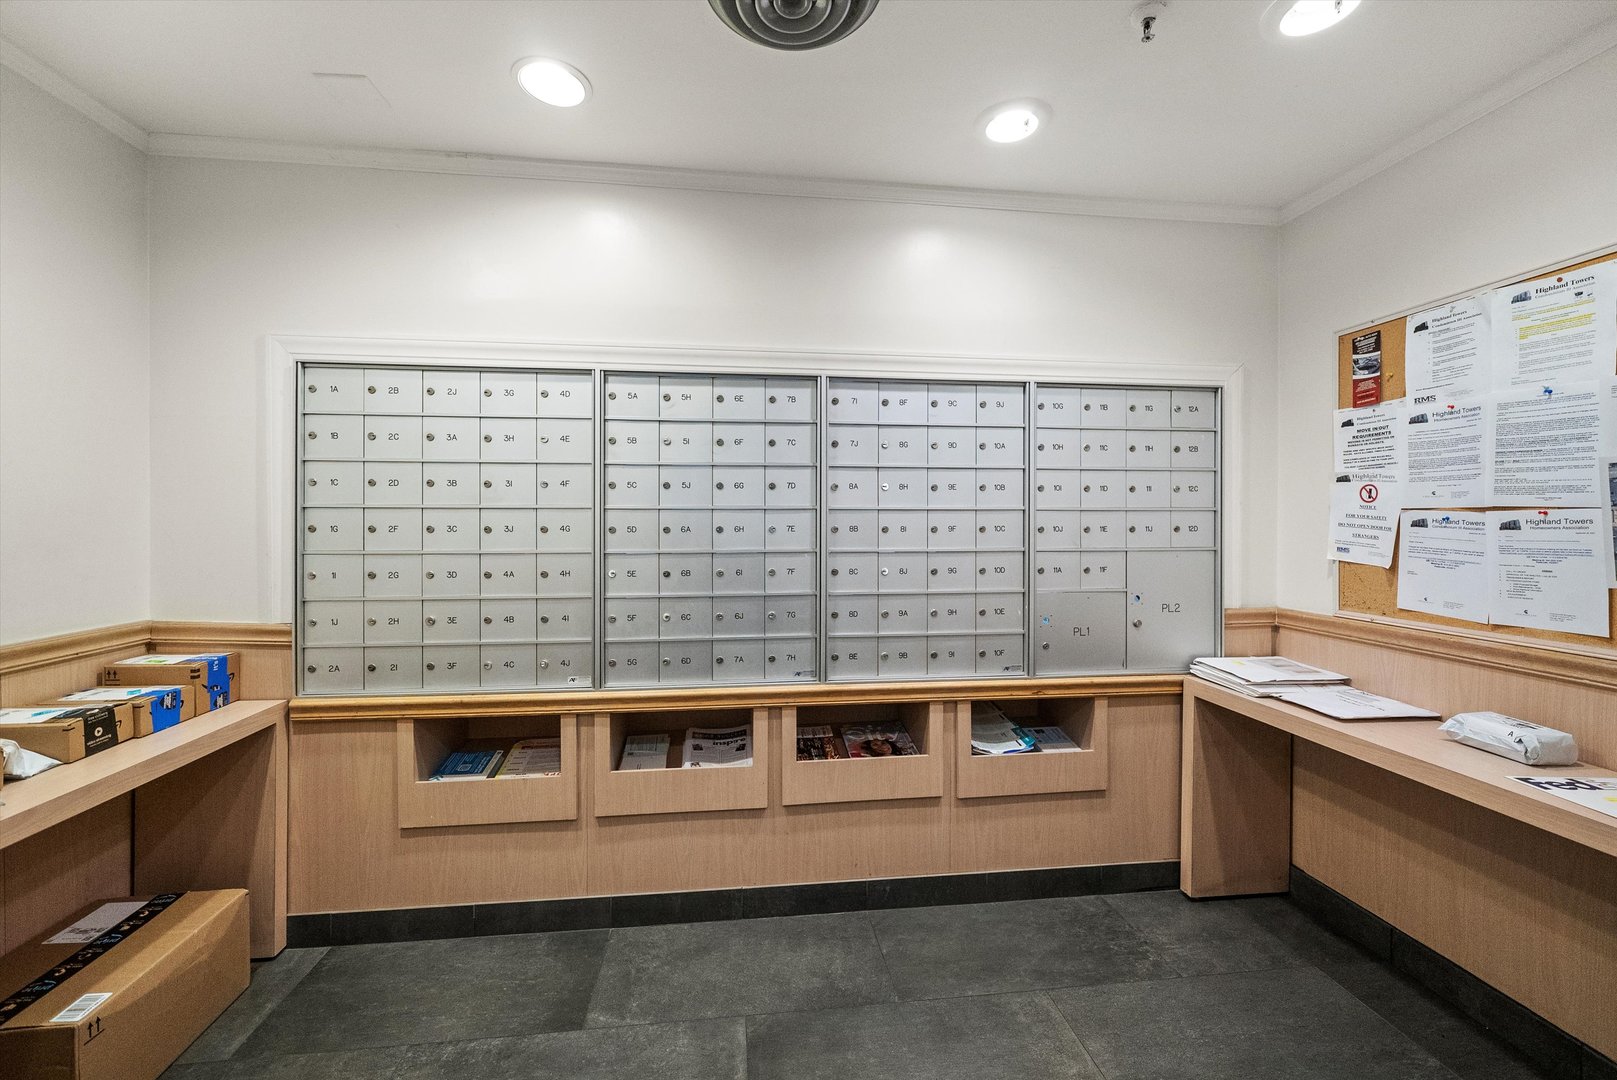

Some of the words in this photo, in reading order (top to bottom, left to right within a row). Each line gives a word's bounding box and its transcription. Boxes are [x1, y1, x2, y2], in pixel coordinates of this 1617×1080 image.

[1535, 282, 1568, 294] Highland
[1570, 276, 1595, 286] Towers
[330, 385, 339, 393] 1A
[387, 386, 400, 395] 2B
[447, 387, 458, 396] 2J
[503, 388, 515, 397] 3G
[559, 390, 571, 398] 4D
[627, 392, 639, 400] 5A
[680, 393, 692, 401] 5H
[733, 394, 744, 403] 6E
[786, 395, 797, 404] 7B
[850, 397, 858, 405] 7I
[898, 398, 908, 407] 8F
[1414, 394, 1436, 404] RMS
[947, 399, 958, 408] 9C
[995, 400, 1005, 409] 9J
[1052, 402, 1064, 410] 10G
[1099, 403, 1109, 411] 11B
[1144, 404, 1154, 412] 11G
[1188, 405, 1199, 413] 12A
[1432, 408, 1461, 418] Highland
[1462, 405, 1482, 413] Towers
[330, 431, 339, 440] 1B
[387, 432, 400, 441] 2C
[446, 433, 458, 442] 3A
[503, 434, 515, 442] 3H
[559, 435, 571, 443] 4E
[1352, 430, 1392, 440] REQUIREMENTS
[626, 436, 638, 445] 5B
[682, 437, 690, 445] 5I
[733, 438, 744, 446] 6F
[786, 438, 797, 447] 7C
[850, 439, 859, 448] 7J
[898, 440, 909, 449] 8G
[947, 441, 958, 449] 9D
[994, 442, 1006, 450] 10A
[1052, 443, 1064, 451] 10H
[1099, 444, 1109, 452] 11C
[1188, 445, 1199, 453] 12B
[330, 478, 339, 487] 1C
[388, 478, 400, 487] 2D
[446, 479, 458, 487] 3B
[505, 479, 513, 488] 3I
[559, 479, 570, 488] 4F
[626, 481, 638, 489] 5C
[681, 481, 692, 489] 5J
[733, 481, 745, 490] 6G
[786, 481, 797, 490] 7D
[848, 482, 859, 490] 8A
[898, 483, 909, 491] 8H
[947, 483, 958, 491] 9E
[993, 483, 1006, 491] 10B
[1099, 484, 1109, 493] 11D
[1187, 485, 1199, 493] 12C
[330, 525, 339, 533] 1G
[388, 525, 399, 533] 2F
[446, 524, 458, 533] 3C
[503, 525, 514, 533] 3J
[559, 524, 571, 533] 4G
[626, 525, 638, 534] 5D
[680, 525, 692, 533] 6A
[733, 525, 745, 533] 6H
[786, 524, 796, 533] 7E
[848, 525, 859, 533] 8B
[899, 525, 907, 533] 8I
[947, 525, 957, 533] 9F
[994, 525, 1006, 533] 10C
[1052, 525, 1064, 533] 10J
[1099, 525, 1109, 533] 11E
[1145, 525, 1153, 533] 11J
[1187, 524, 1199, 533] 12D
[503, 570, 515, 578] 4A
[559, 570, 571, 578] 4H
[626, 569, 637, 578] 5E
[680, 569, 692, 577] 6B
[735, 568, 743, 577] 6I
[786, 567, 796, 576] 7F
[848, 567, 859, 576] 8C
[898, 567, 908, 576] 8J
[947, 566, 958, 575] 9G
[993, 566, 1006, 574] 10D
[1053, 566, 1063, 574] 11A
[387, 571, 400, 580] 2G
[446, 570, 458, 579] 3D
[993, 607, 1006, 616] 10E
[1161, 602, 1181, 613] PL2
[734, 612, 744, 620] 6J
[786, 611, 796, 619] 7G
[848, 610, 859, 618] 8D
[898, 609, 909, 617] 9A
[947, 608, 958, 616] 9H
[446, 616, 458, 625] 3E
[503, 615, 515, 624] 4B
[561, 614, 570, 622] 4I
[626, 614, 637, 622] 5F
[680, 613, 692, 621] 6C
[330, 618, 339, 626] 1J
[387, 617, 400, 626] 2H
[1073, 626, 1090, 637] PL1
[848, 652, 858, 661] 8E
[898, 651, 909, 660] 9B
[947, 650, 956, 658] 9I
[993, 649, 1005, 657] 10F
[626, 658, 638, 666] 5G
[680, 656, 692, 665] 6D
[733, 655, 745, 663] 7A
[786, 654, 796, 662] 7H
[446, 662, 458, 670] 3F
[503, 660, 515, 669] 4C
[560, 659, 571, 667] 4J
[328, 664, 341, 673] 2A
[389, 663, 398, 672] 2I
